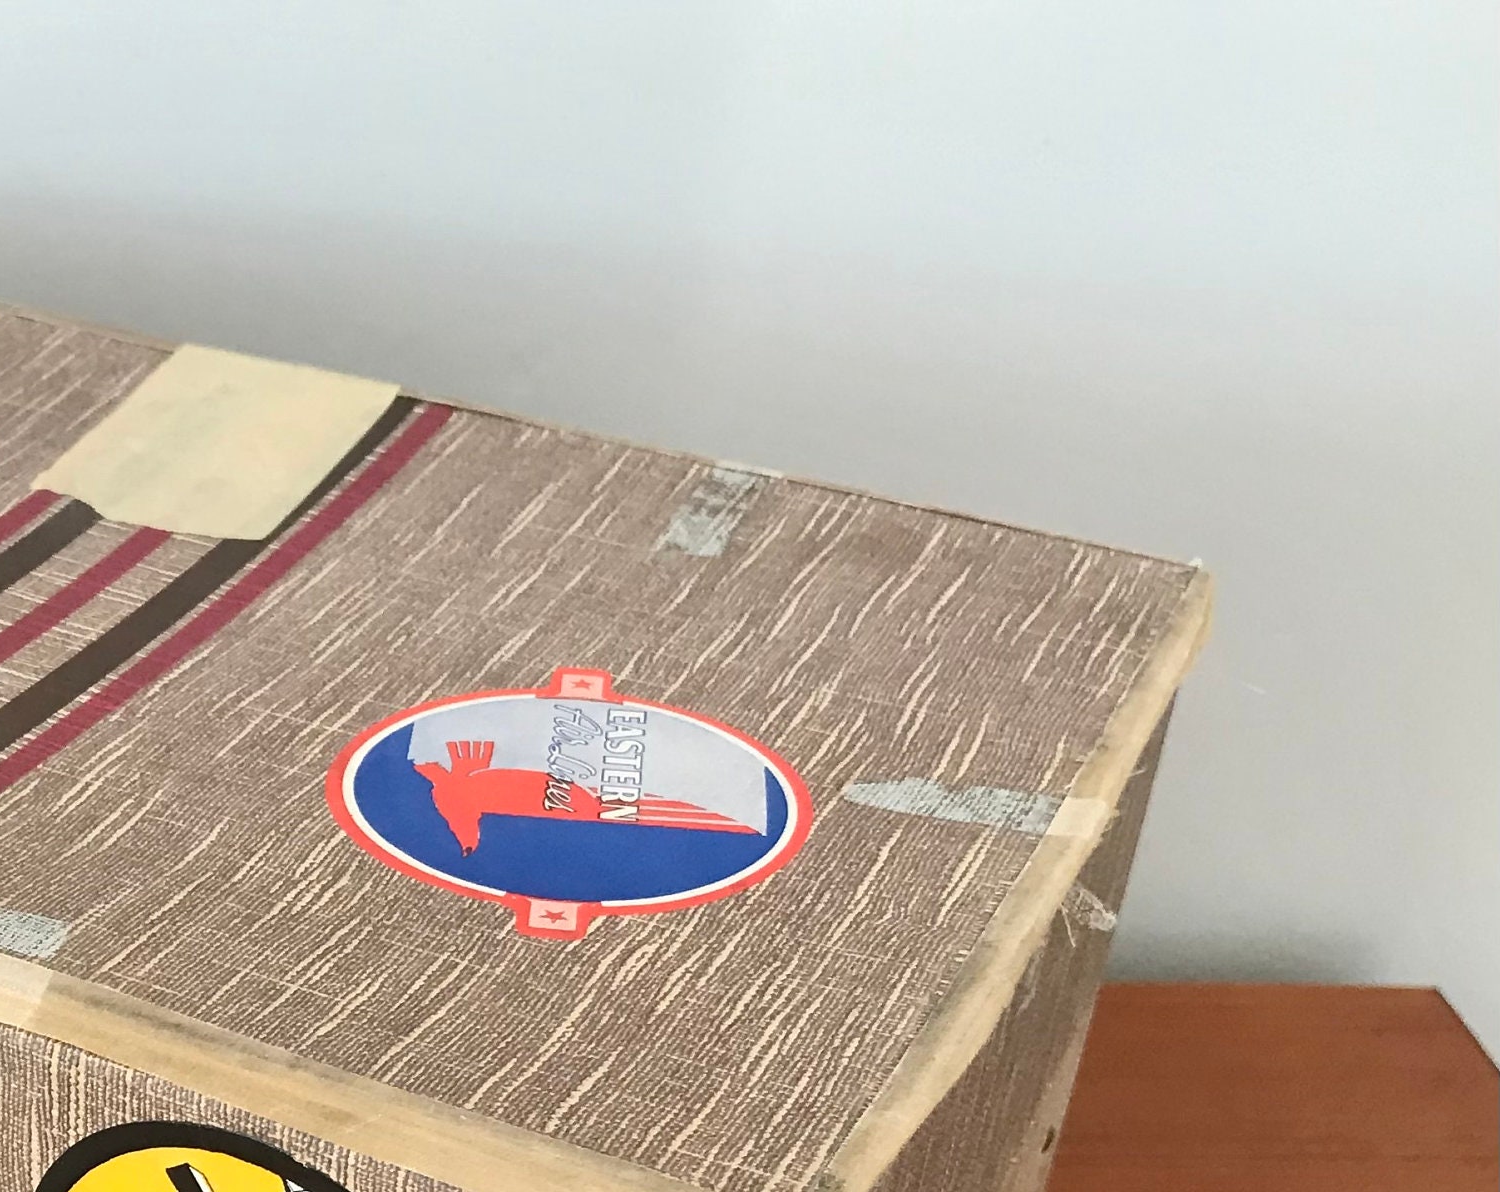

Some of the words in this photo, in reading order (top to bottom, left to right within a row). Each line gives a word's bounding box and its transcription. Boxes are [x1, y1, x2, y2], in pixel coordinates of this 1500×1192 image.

[552, 704, 603, 745] Air
[543, 743, 597, 812] Lines
[598, 708, 647, 821] EASTERN
